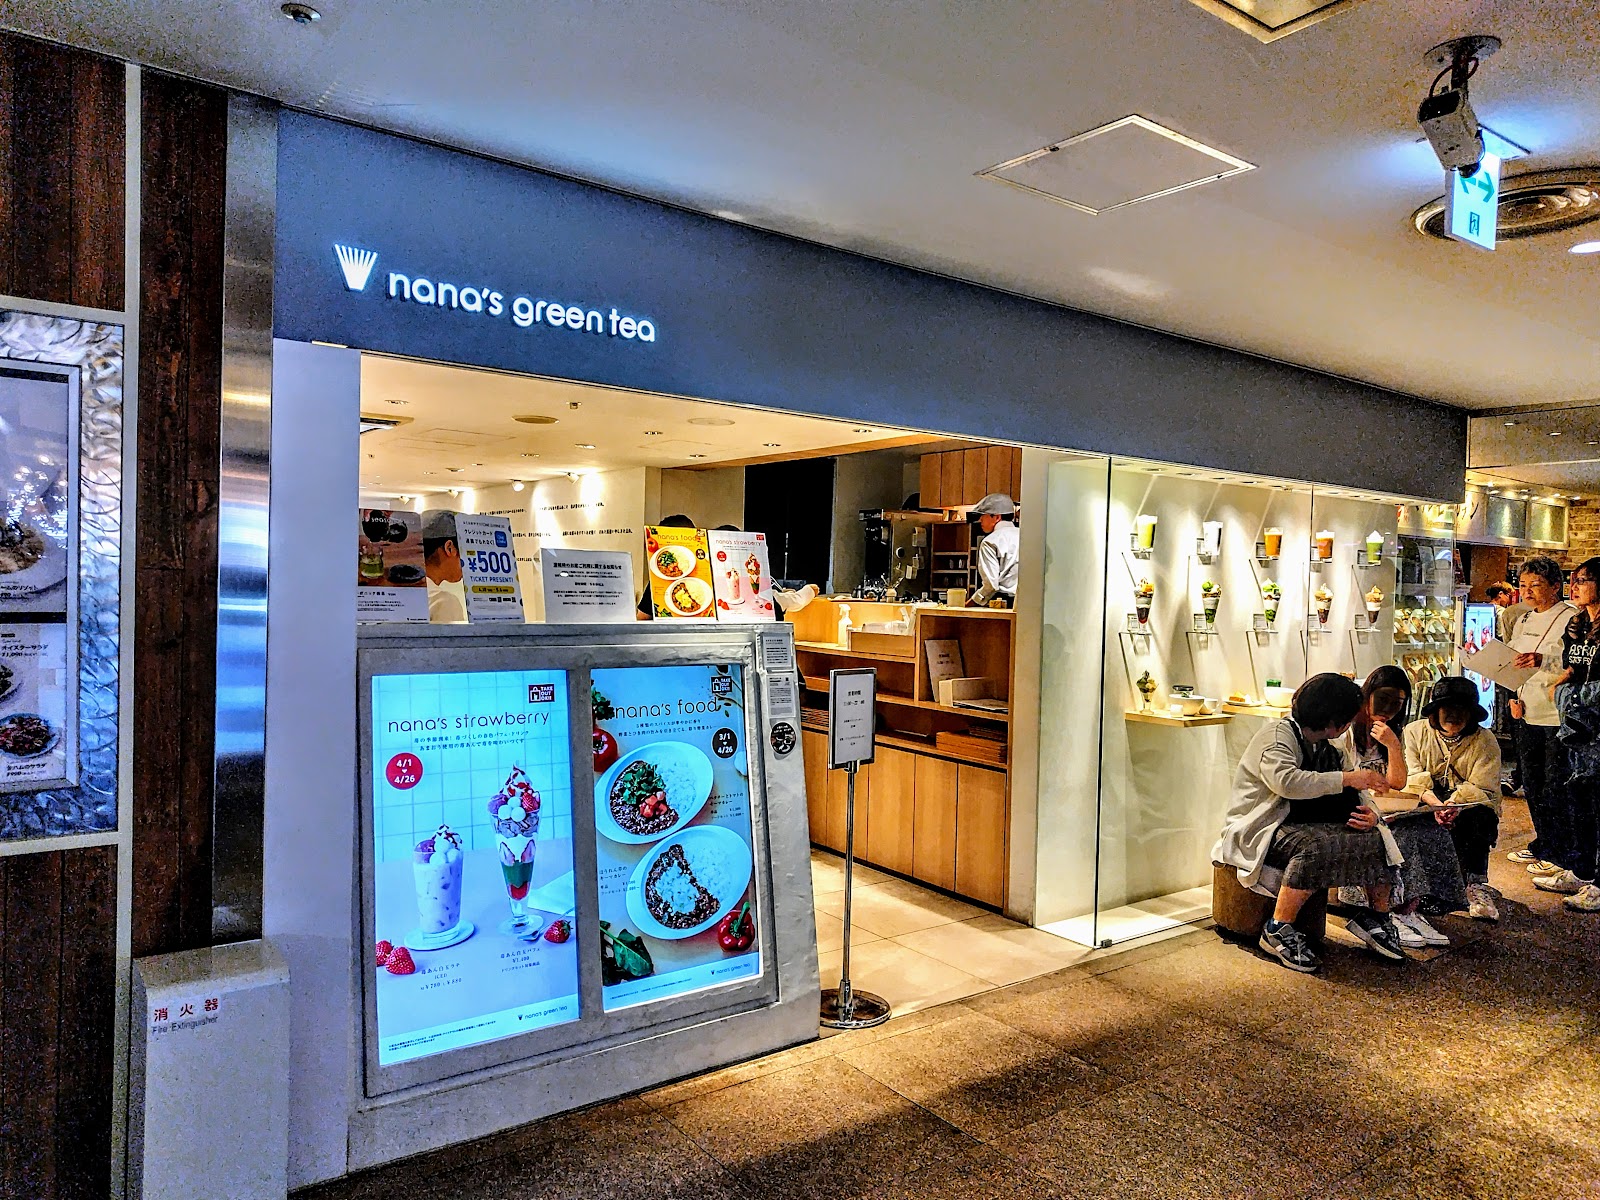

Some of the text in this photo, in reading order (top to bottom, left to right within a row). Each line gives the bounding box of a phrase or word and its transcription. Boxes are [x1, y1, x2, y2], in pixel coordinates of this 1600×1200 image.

[388, 271, 656, 343] nana's green tea
[733, 539, 762, 547] strawberry
[467, 550, 512, 574] ¥500
[614, 696, 717, 719] nana's food
[388, 711, 550, 733] nana's strawberry
[718, 732, 731, 741] 3/1
[717, 745, 734, 754] 4/26
[396, 759, 412, 768] 4/1
[394, 775, 416, 784] 4/26
[153, 997, 219, 1023] 消火器
[524, 1011, 542, 1020] nana's
[543, 1007, 559, 1016] green
[151, 1015, 219, 1035] Fire Extinguisher
